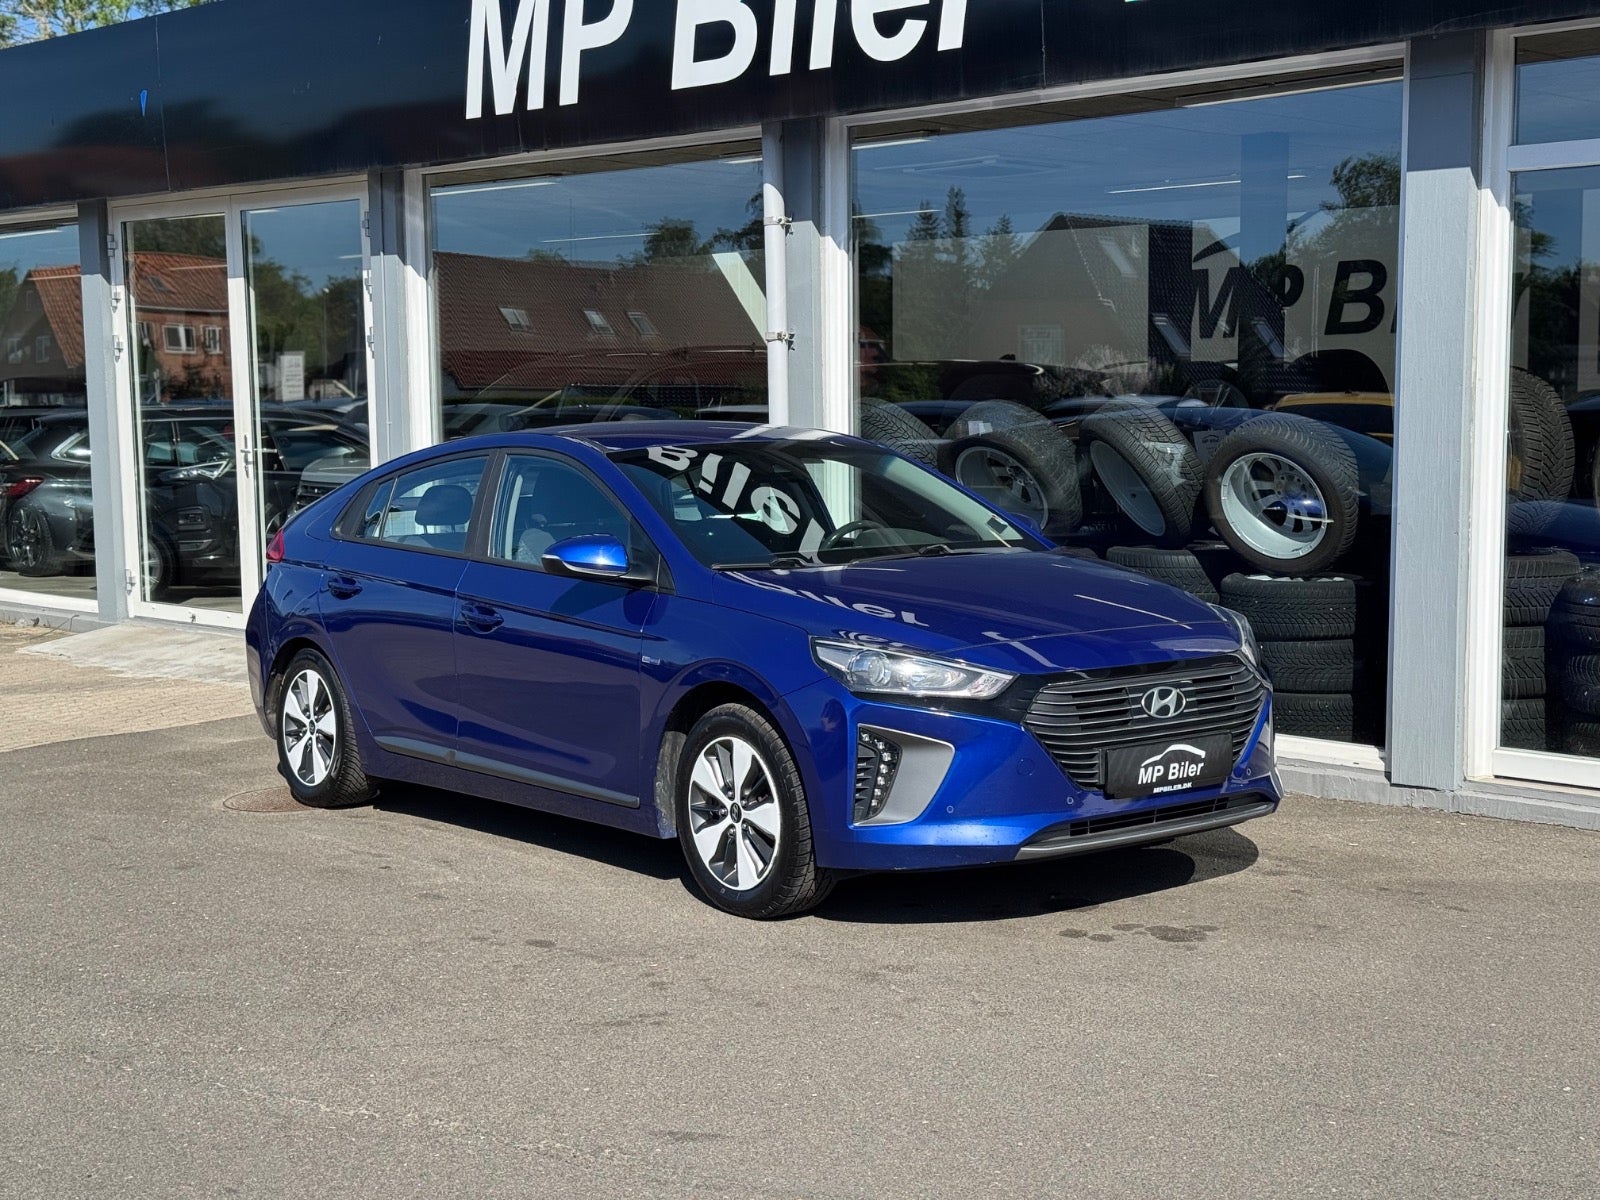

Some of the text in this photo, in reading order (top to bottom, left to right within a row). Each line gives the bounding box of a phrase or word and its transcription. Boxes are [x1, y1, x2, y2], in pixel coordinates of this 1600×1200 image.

[465, 0, 633, 119] MP
[1138, 761, 1204, 785] MP Biler
